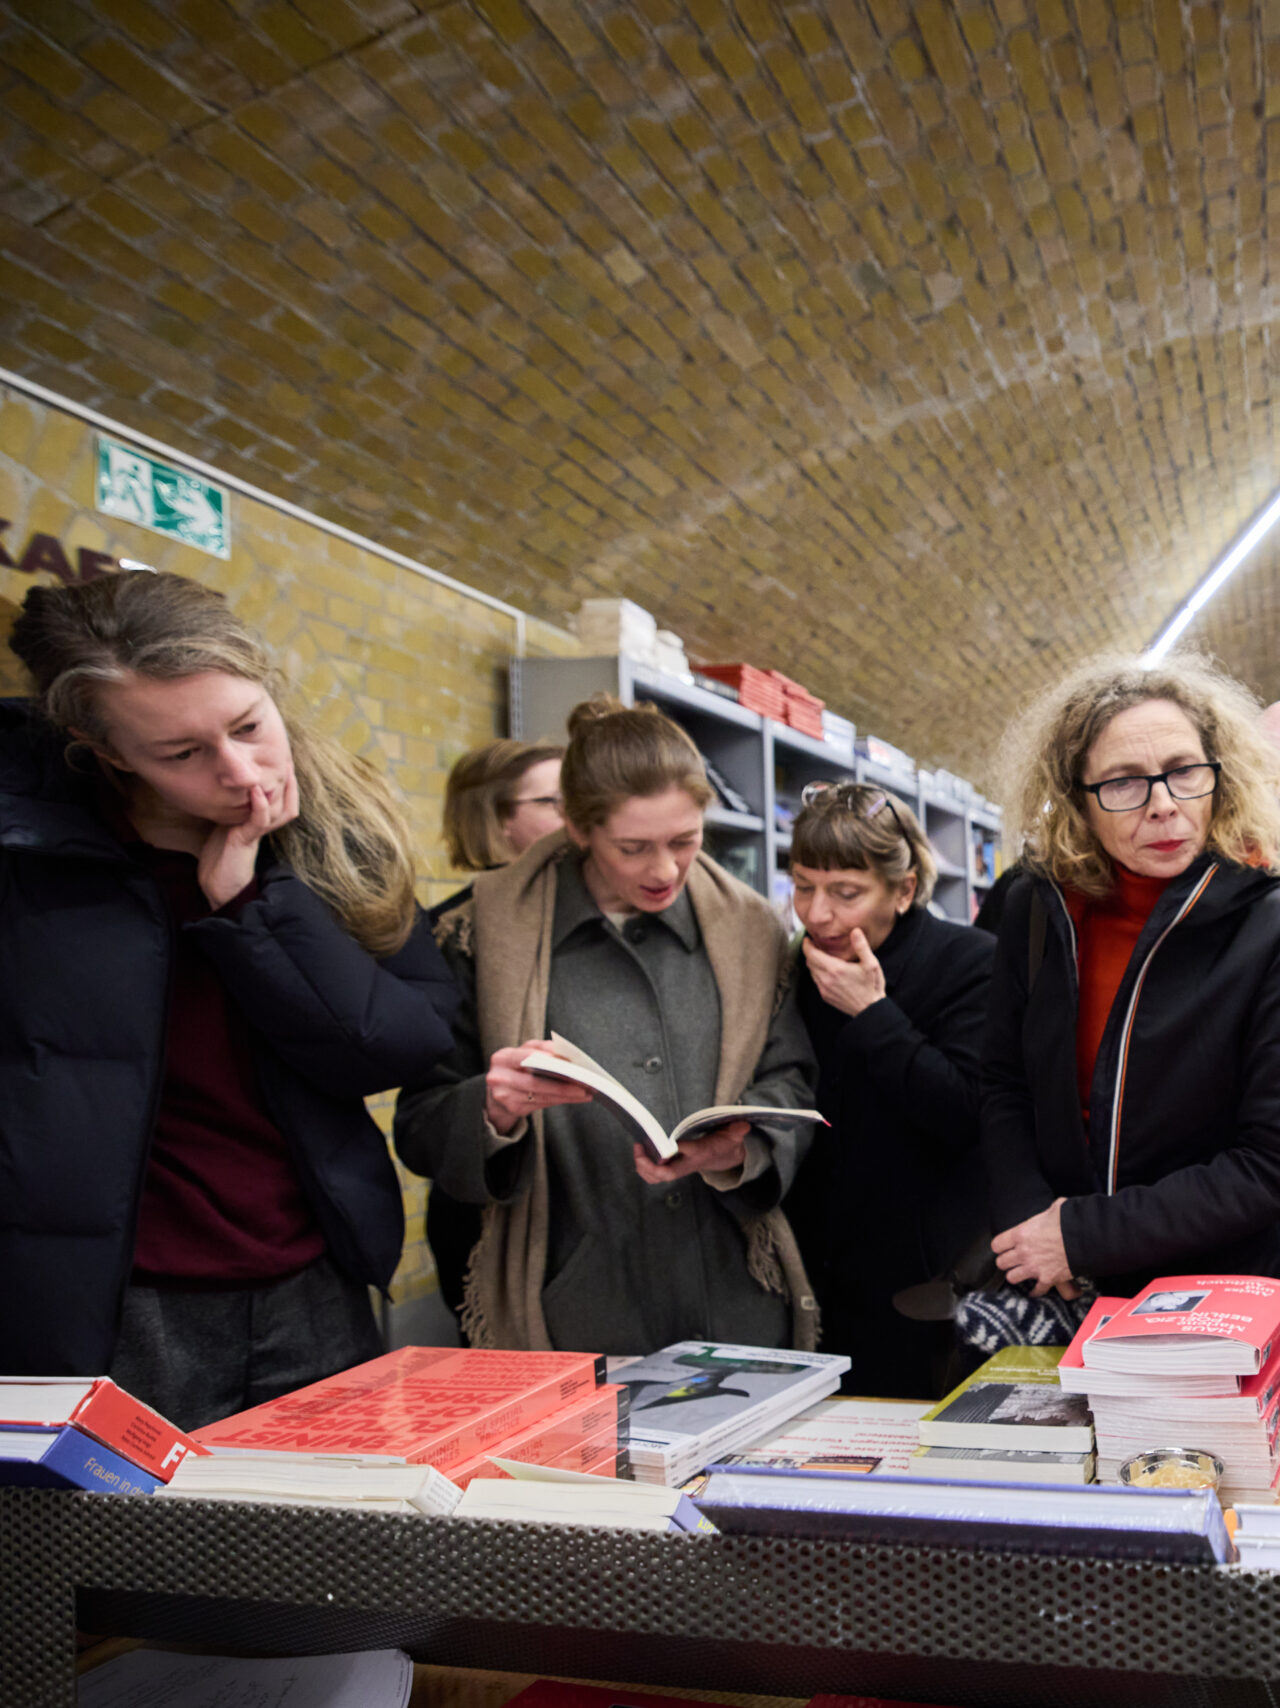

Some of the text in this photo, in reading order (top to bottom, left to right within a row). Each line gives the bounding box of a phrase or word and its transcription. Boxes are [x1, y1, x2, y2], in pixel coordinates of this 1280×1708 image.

[313, 1387, 514, 1405] PRACTICE
[417, 1405, 482, 1419] OF
[261, 1417, 457, 1434] FUTURES
[210, 1428, 424, 1450] FEMINIST
[84, 1457, 121, 1487] Frauen
[119, 1479, 132, 1493] in
